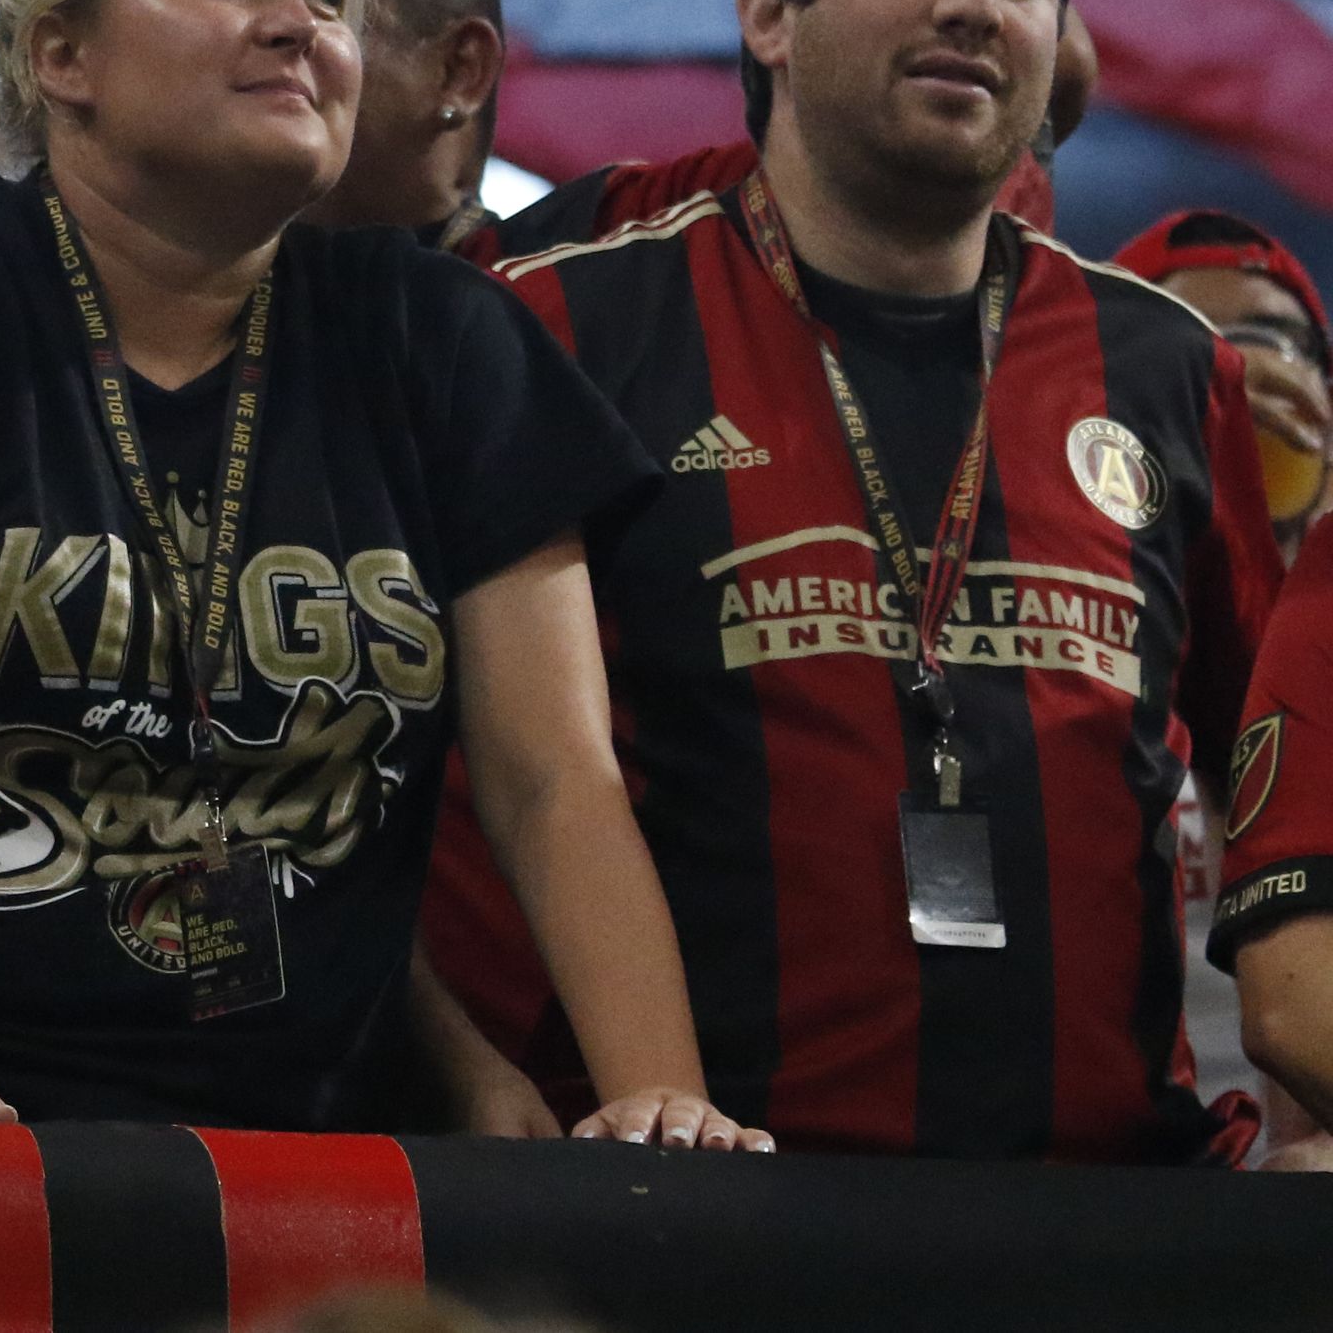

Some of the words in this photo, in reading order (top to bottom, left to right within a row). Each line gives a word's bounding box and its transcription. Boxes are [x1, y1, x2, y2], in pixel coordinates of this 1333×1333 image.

[76, 290, 108, 340] UNITE
[245, 282, 273, 357] CONQUER
[986, 288, 1005, 333] UNITE
[102, 378, 127, 426] BOLD
[236, 391, 257, 419] WE
[115, 434, 140, 468] AND
[230, 421, 253, 455] ARE
[1078, 423, 1145, 460] ATLANTA
[671, 448, 772, 474] adidas
[213, 498, 241, 557] BLACK,
[877, 511, 903, 548] AND
[891, 548, 920, 597] BOLD
[211, 561, 231, 599] AND
[203, 600, 227, 650] BOLD
[719, 576, 970, 624] AMERICN
[990, 587, 1140, 650] FAMILY
[81, 699, 121, 730] of
[124, 700, 173, 739] the
[1239, 869, 1307, 912] UNITED
[117, 924, 187, 969] UNITED
[190, 950, 215, 967] AND
